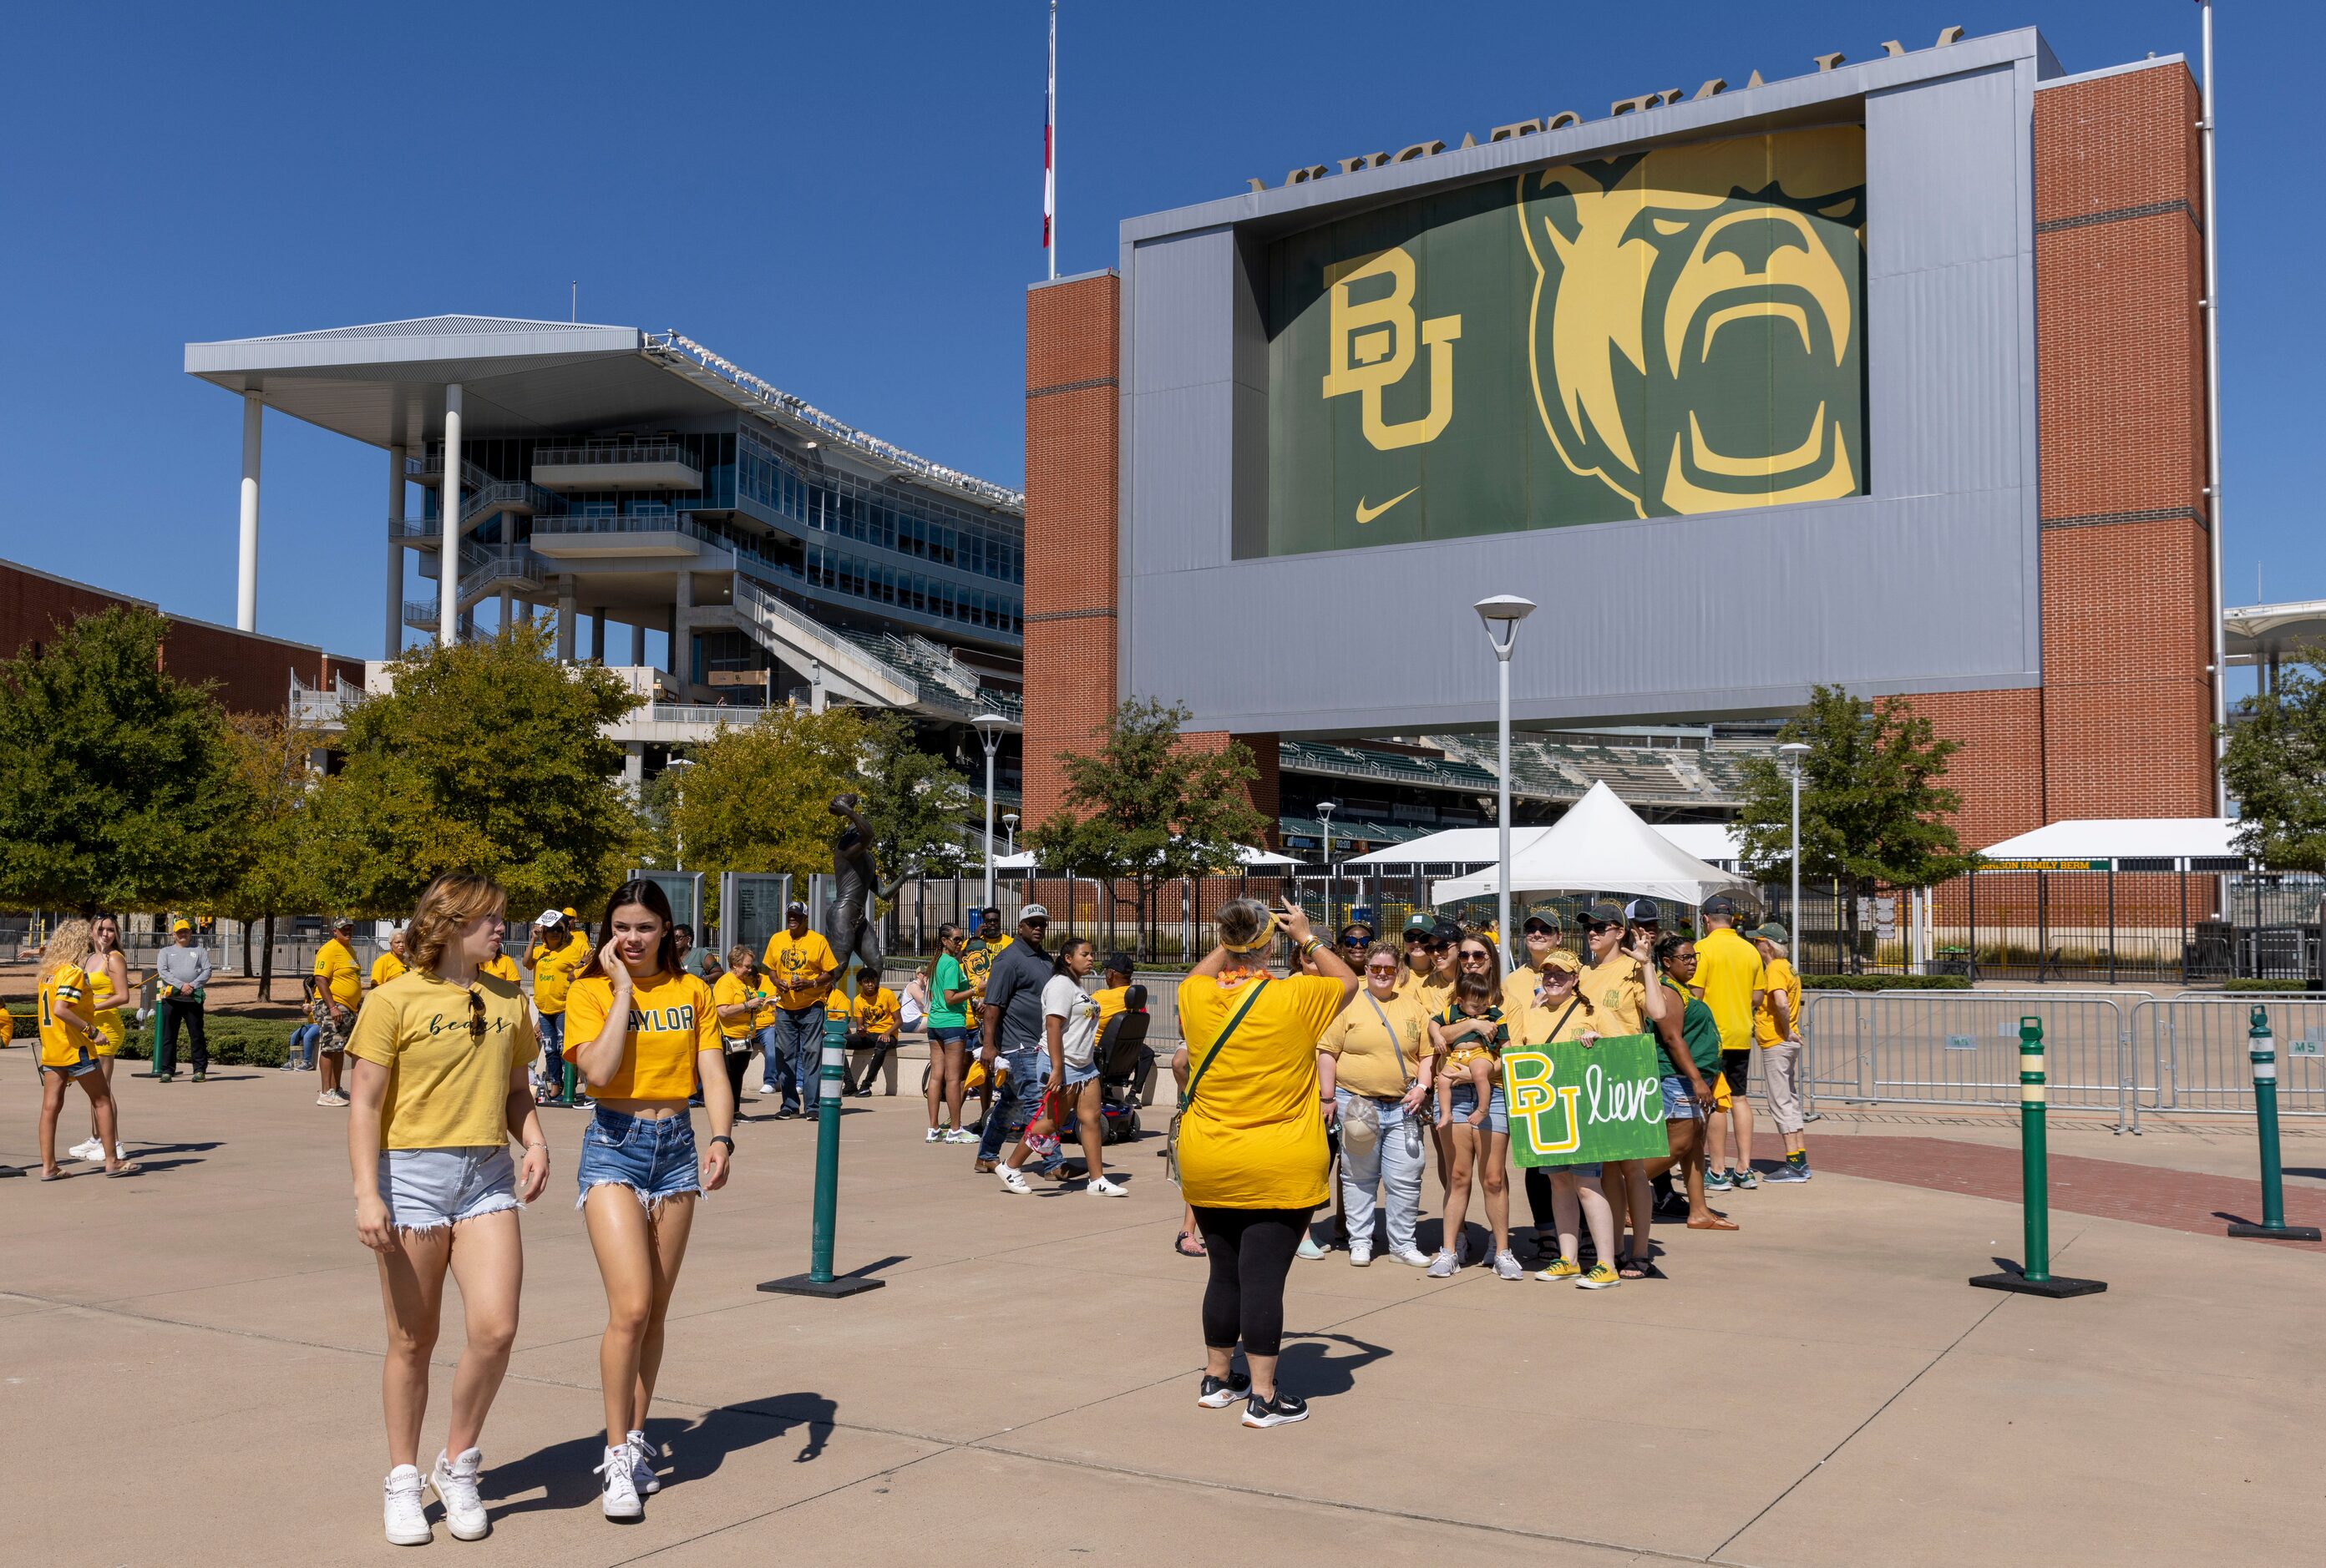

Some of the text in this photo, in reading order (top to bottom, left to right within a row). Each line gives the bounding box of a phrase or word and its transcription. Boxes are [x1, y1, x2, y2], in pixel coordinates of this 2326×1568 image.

[1323, 246, 1462, 451] BU
[1336, 840, 1350, 848] 90:00
[43, 989, 53, 1027] 1
[626, 1004, 695, 1033] AYLOR
[429, 1013, 512, 1035] beas
[392, 1472, 417, 1484] adidas
